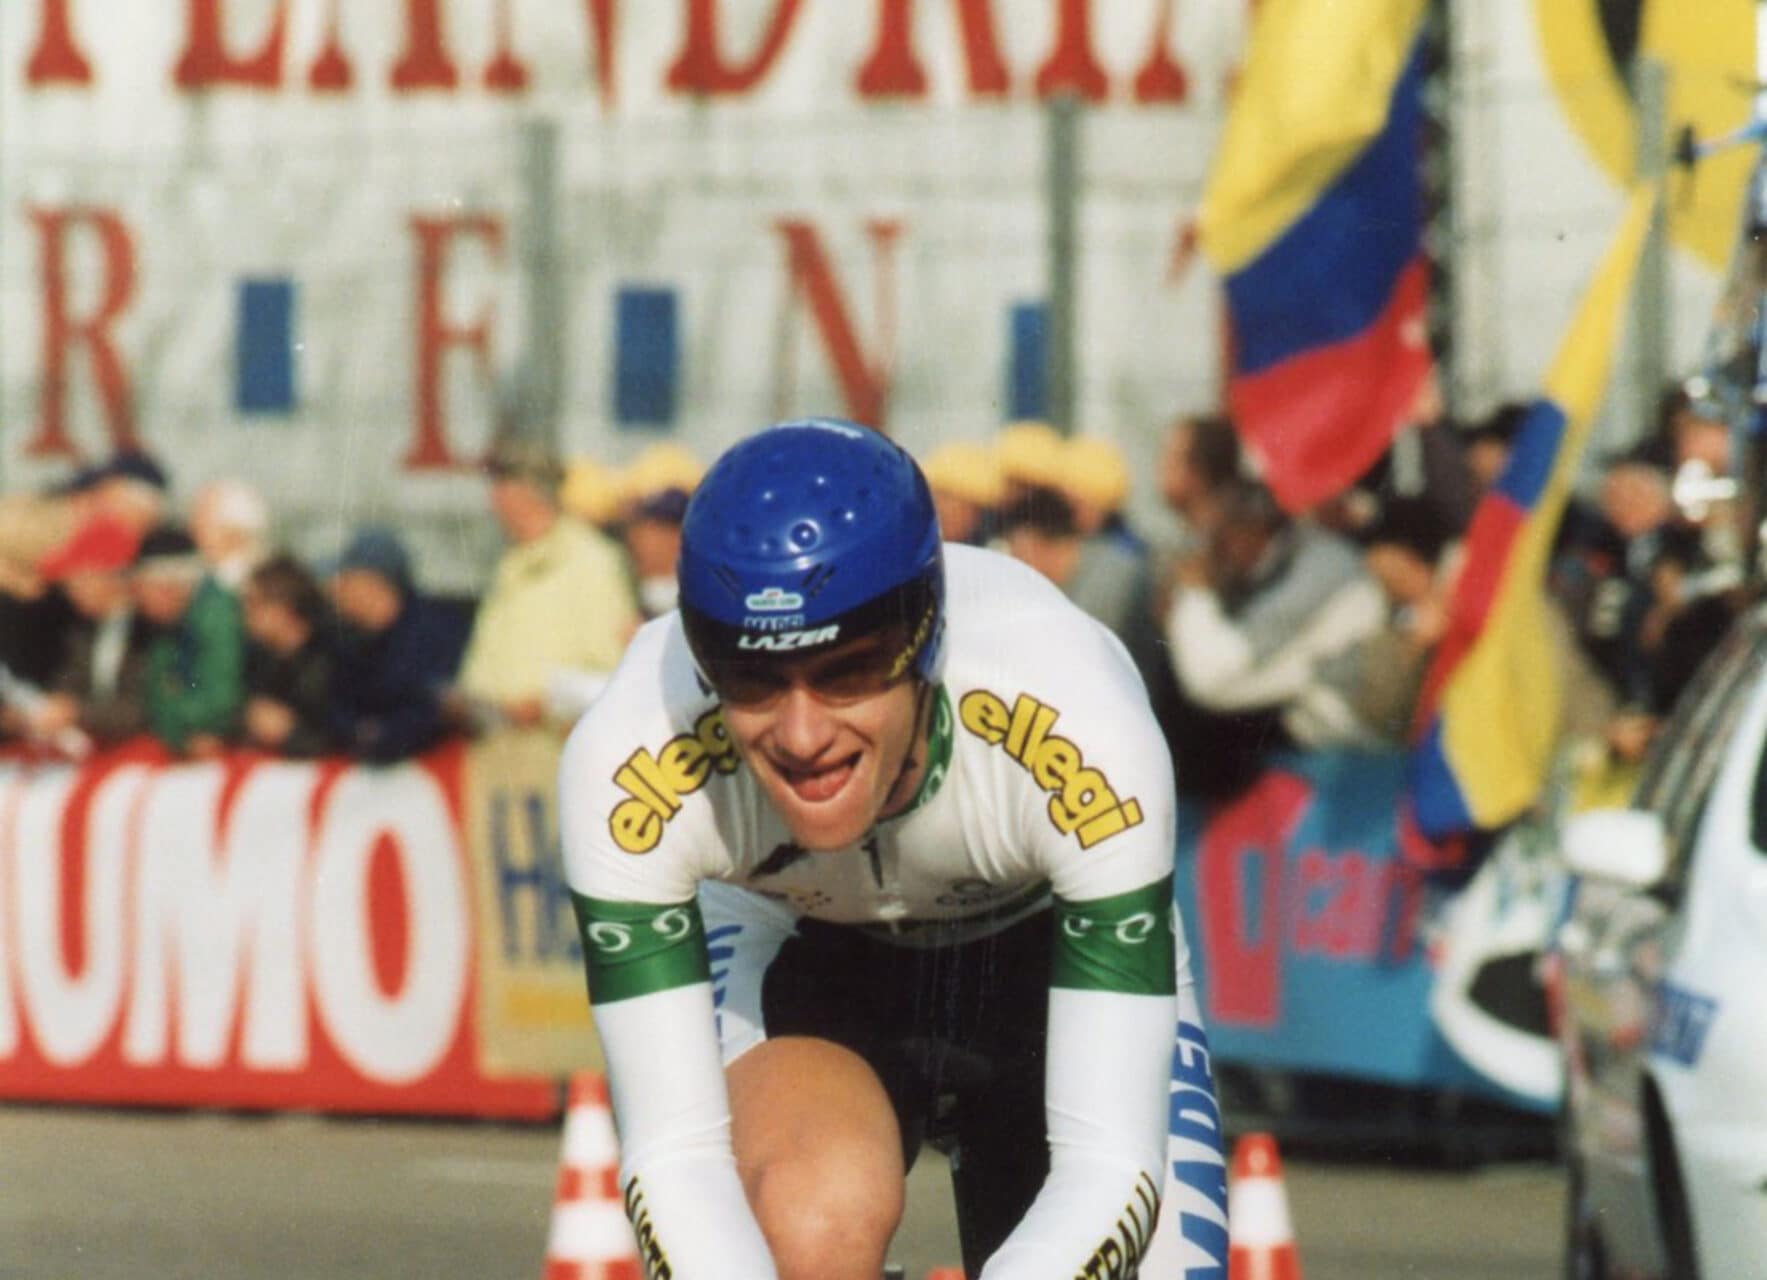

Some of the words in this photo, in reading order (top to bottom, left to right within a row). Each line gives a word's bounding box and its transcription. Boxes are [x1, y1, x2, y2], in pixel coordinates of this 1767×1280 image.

[738, 623, 841, 651] LAZER
[609, 702, 740, 854] elleg
[958, 688, 1144, 850] ellegi
[0, 758, 473, 1086] UMO
